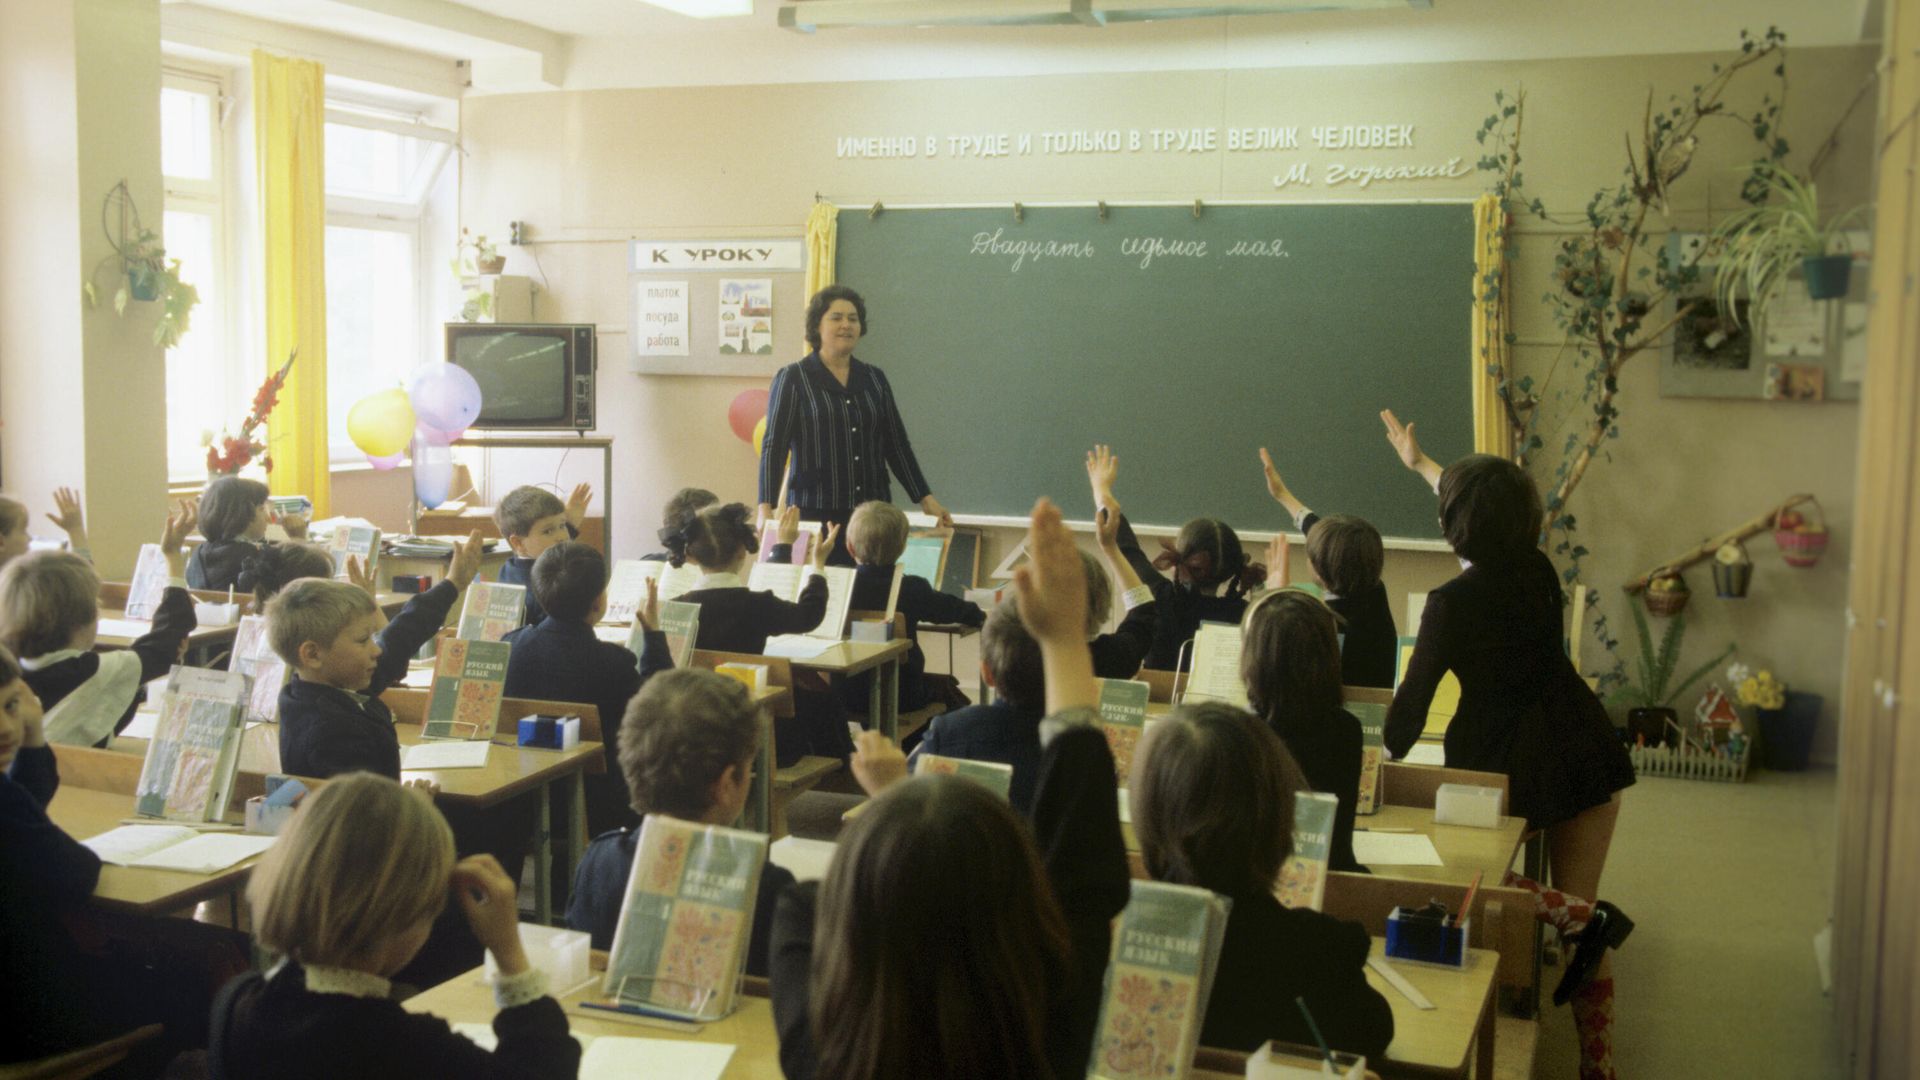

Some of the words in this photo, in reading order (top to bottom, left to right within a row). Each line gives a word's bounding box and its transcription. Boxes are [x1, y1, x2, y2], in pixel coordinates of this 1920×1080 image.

[836, 136, 917, 158] ИМЕННО
[925, 136, 938, 157] В
[948, 134, 1009, 158] ТРУДЕ
[1017, 133, 1032, 156] И
[1041, 129, 1121, 154] ТОЛЬКО
[1129, 129, 1142, 150] В
[1150, 127, 1217, 152] ТРУДЕ
[1227, 126, 1299, 150] ВЕЛИК
[1311, 124, 1414, 149] ЧЕЛОВЕК
[652, 249, 670, 263] К
[683, 248, 773, 262] УРОКУ
[970, 227, 1095, 273] Двадцать
[1226, 238, 1290, 258] мая.
[647, 287, 681, 298] платок
[645, 311, 680, 325] посуда
[646, 333, 680, 348] работа
[466, 660, 503, 671] РУССКИЙ
[464, 669, 489, 678] ЯЗЫК
[1101, 703, 1144, 716] РУССКИЙ
[1125, 929, 1200, 956] РУССКИЙ
[1123, 945, 1170, 966] ЯЗЫК
